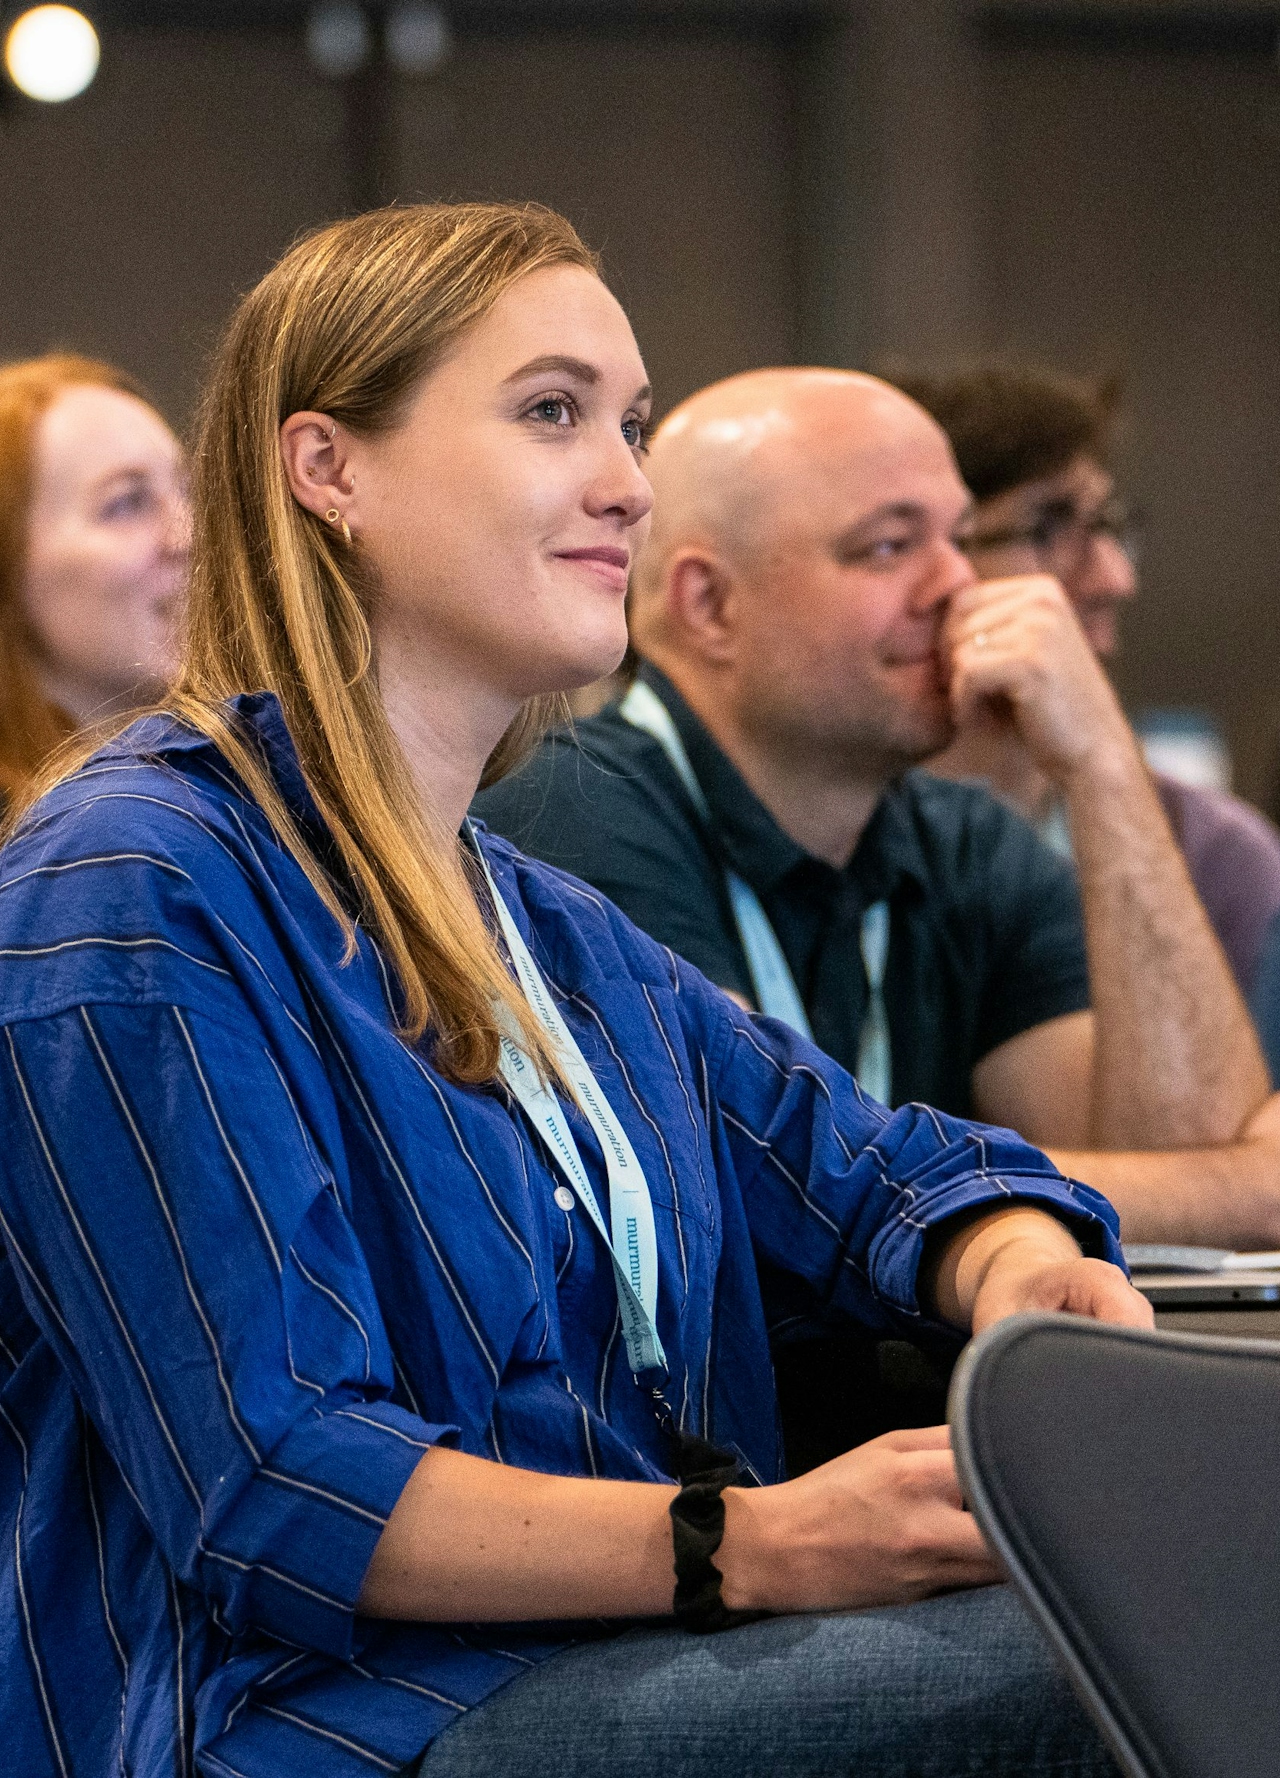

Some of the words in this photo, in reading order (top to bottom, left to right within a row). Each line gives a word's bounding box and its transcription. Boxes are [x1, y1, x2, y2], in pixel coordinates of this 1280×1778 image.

[520, 956, 564, 1045] murmuration
[578, 1081, 628, 1168] murmuration
[546, 1116, 601, 1222] murmuration
[627, 1217, 644, 1301] murmur
